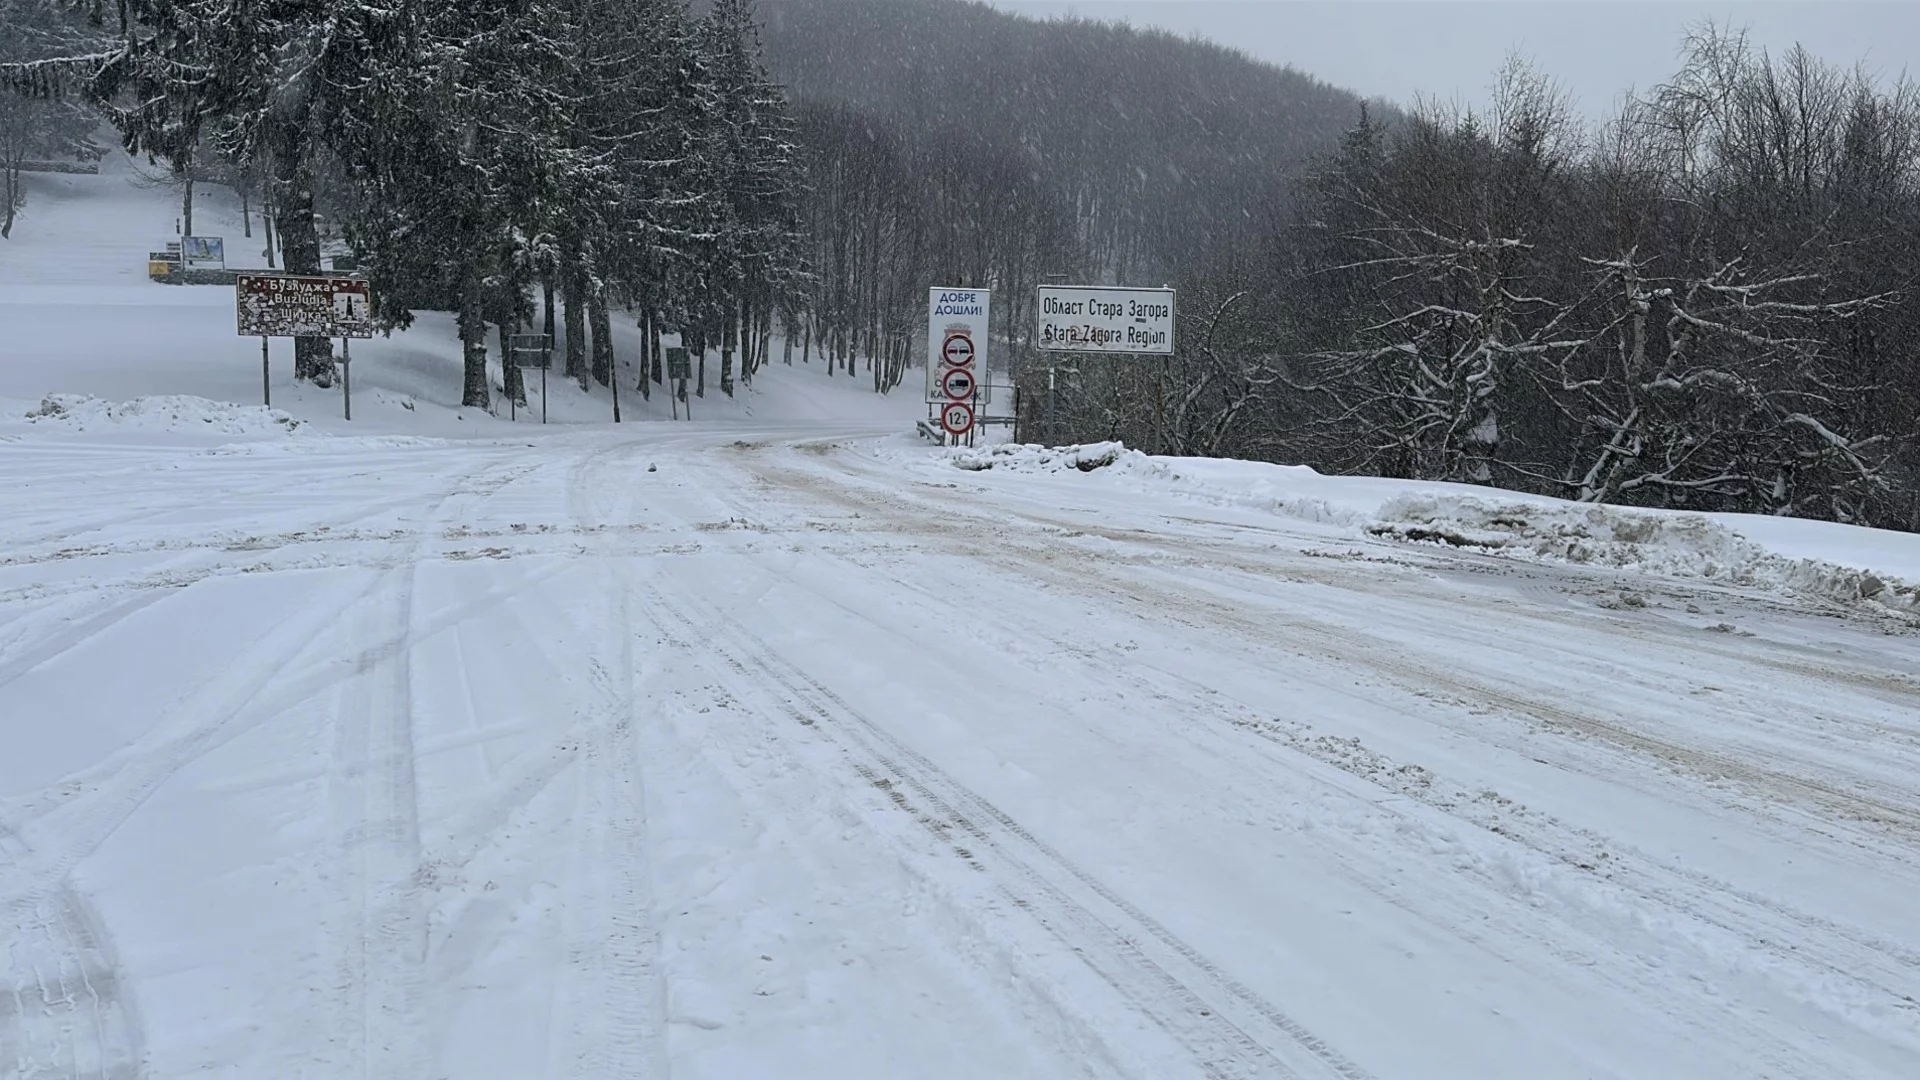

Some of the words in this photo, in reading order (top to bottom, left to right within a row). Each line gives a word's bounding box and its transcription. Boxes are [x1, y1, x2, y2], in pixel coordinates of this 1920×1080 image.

[269, 279, 331, 293] Бузлуджа
[274, 293, 327, 306] Buzludja
[940, 293, 976, 303] ДОБРЕ
[935, 305, 983, 316] ДОШЛИ!
[1043, 297, 1083, 315] Област
[1089, 298, 1123, 320] Стара
[1128, 299, 1168, 322] Загора
[1044, 323, 1077, 341] Stara
[1083, 325, 1122, 346] Zagora
[1128, 326, 1165, 348] Region
